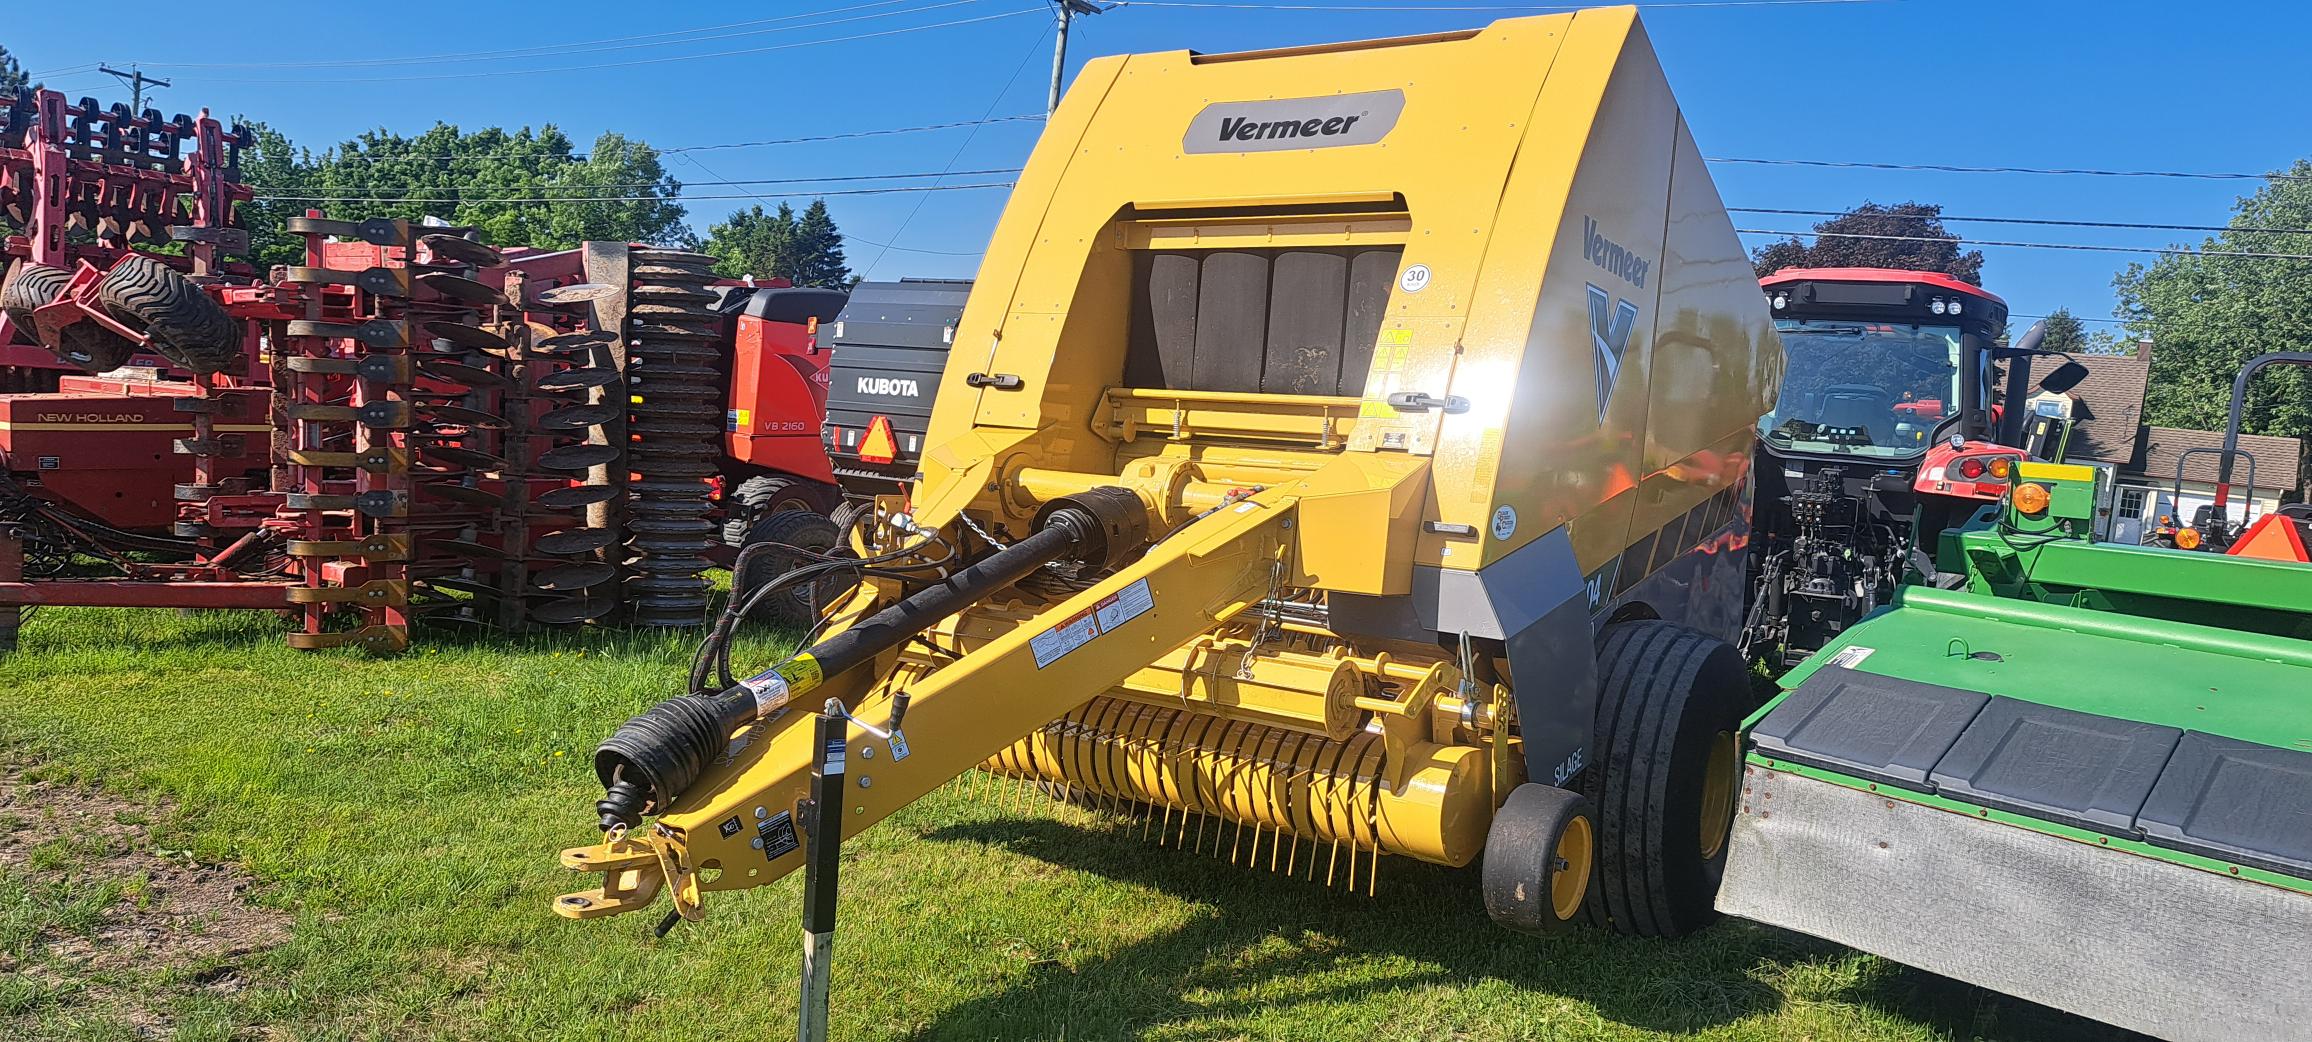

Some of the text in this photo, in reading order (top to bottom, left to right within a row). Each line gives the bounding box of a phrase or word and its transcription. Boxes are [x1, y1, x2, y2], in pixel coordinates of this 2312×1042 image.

[1219, 115, 1360, 142] Vermeer
[1583, 214, 1649, 290] Vermeer
[1407, 270, 1425, 282] 30
[857, 376, 919, 397] KUBOTA
[38, 413, 144, 423] NEW HOLLAND
[764, 421, 805, 431] VB 2160
[1554, 747, 1582, 787] SILAGE
